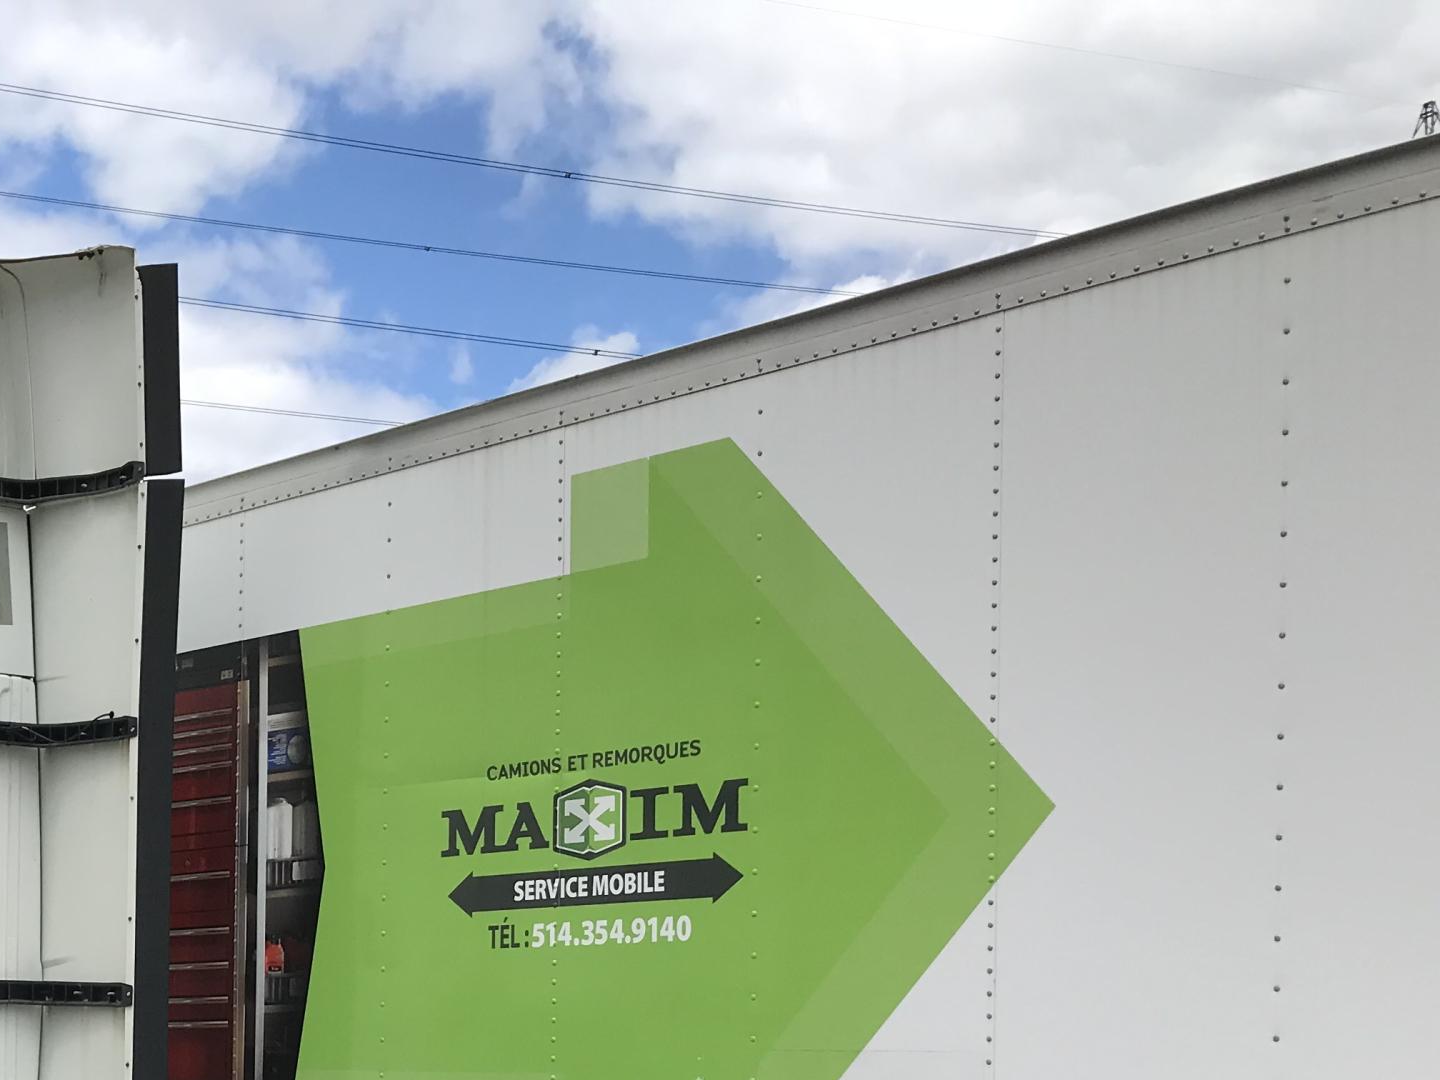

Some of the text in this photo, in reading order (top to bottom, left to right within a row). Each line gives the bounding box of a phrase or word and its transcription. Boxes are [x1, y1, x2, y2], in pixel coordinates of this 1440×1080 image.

[486, 739, 701, 781] CAMIONS ET REMORQUES
[441, 778, 749, 861] MAXIM
[513, 871, 665, 902] SERVICE MOBILE
[531, 915, 692, 949] 514.354.9140
